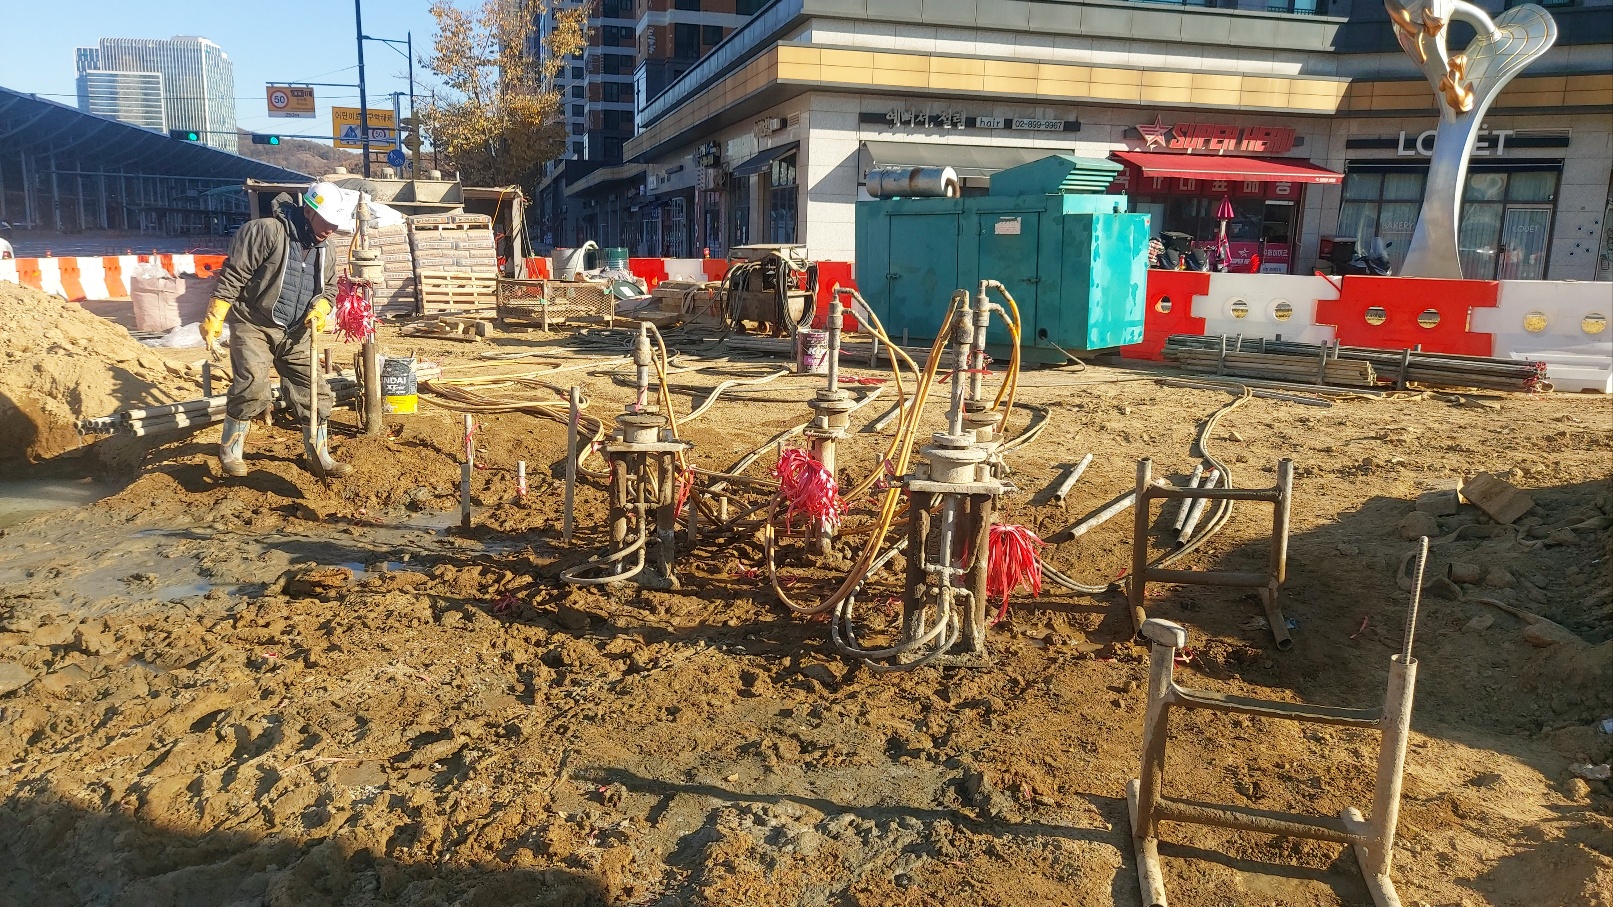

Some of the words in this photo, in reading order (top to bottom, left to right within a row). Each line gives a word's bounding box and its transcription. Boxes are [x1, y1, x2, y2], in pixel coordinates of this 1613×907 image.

[979, 118, 1001, 128] hair
[1170, 123, 1239, 149] SUPER
[1398, 124, 1513, 156] LOËT
[1382, 222, 1414, 230] BAKERY
